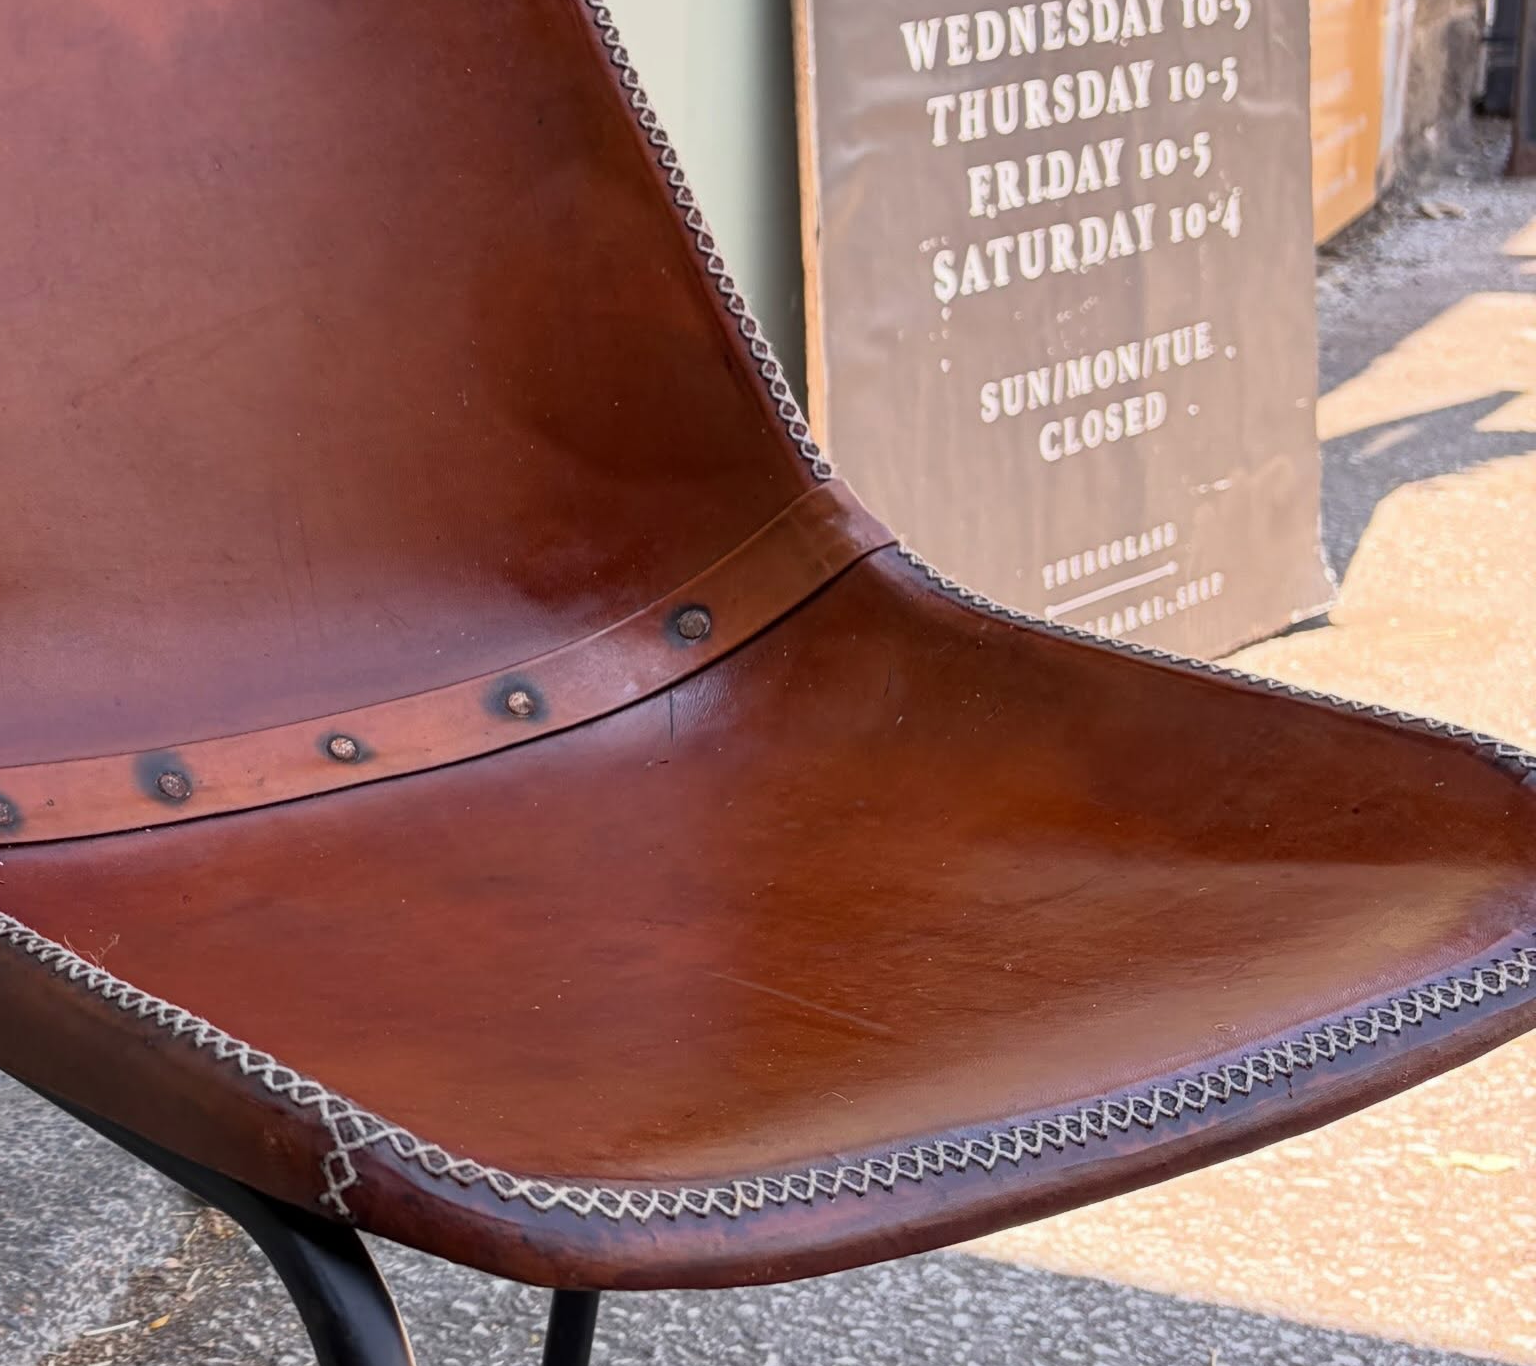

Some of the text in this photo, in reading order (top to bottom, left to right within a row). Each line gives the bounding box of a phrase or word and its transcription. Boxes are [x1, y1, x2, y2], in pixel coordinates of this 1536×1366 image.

[926, 56, 1240, 147] THURSDAY 10-5
[967, 131, 1212, 218] FRIDAY 10-5
[932, 191, 1242, 303] SATURDAY 10-4
[980, 321, 1214, 423] SUN/MON/TUE
[1038, 391, 1168, 462] CLOSED
